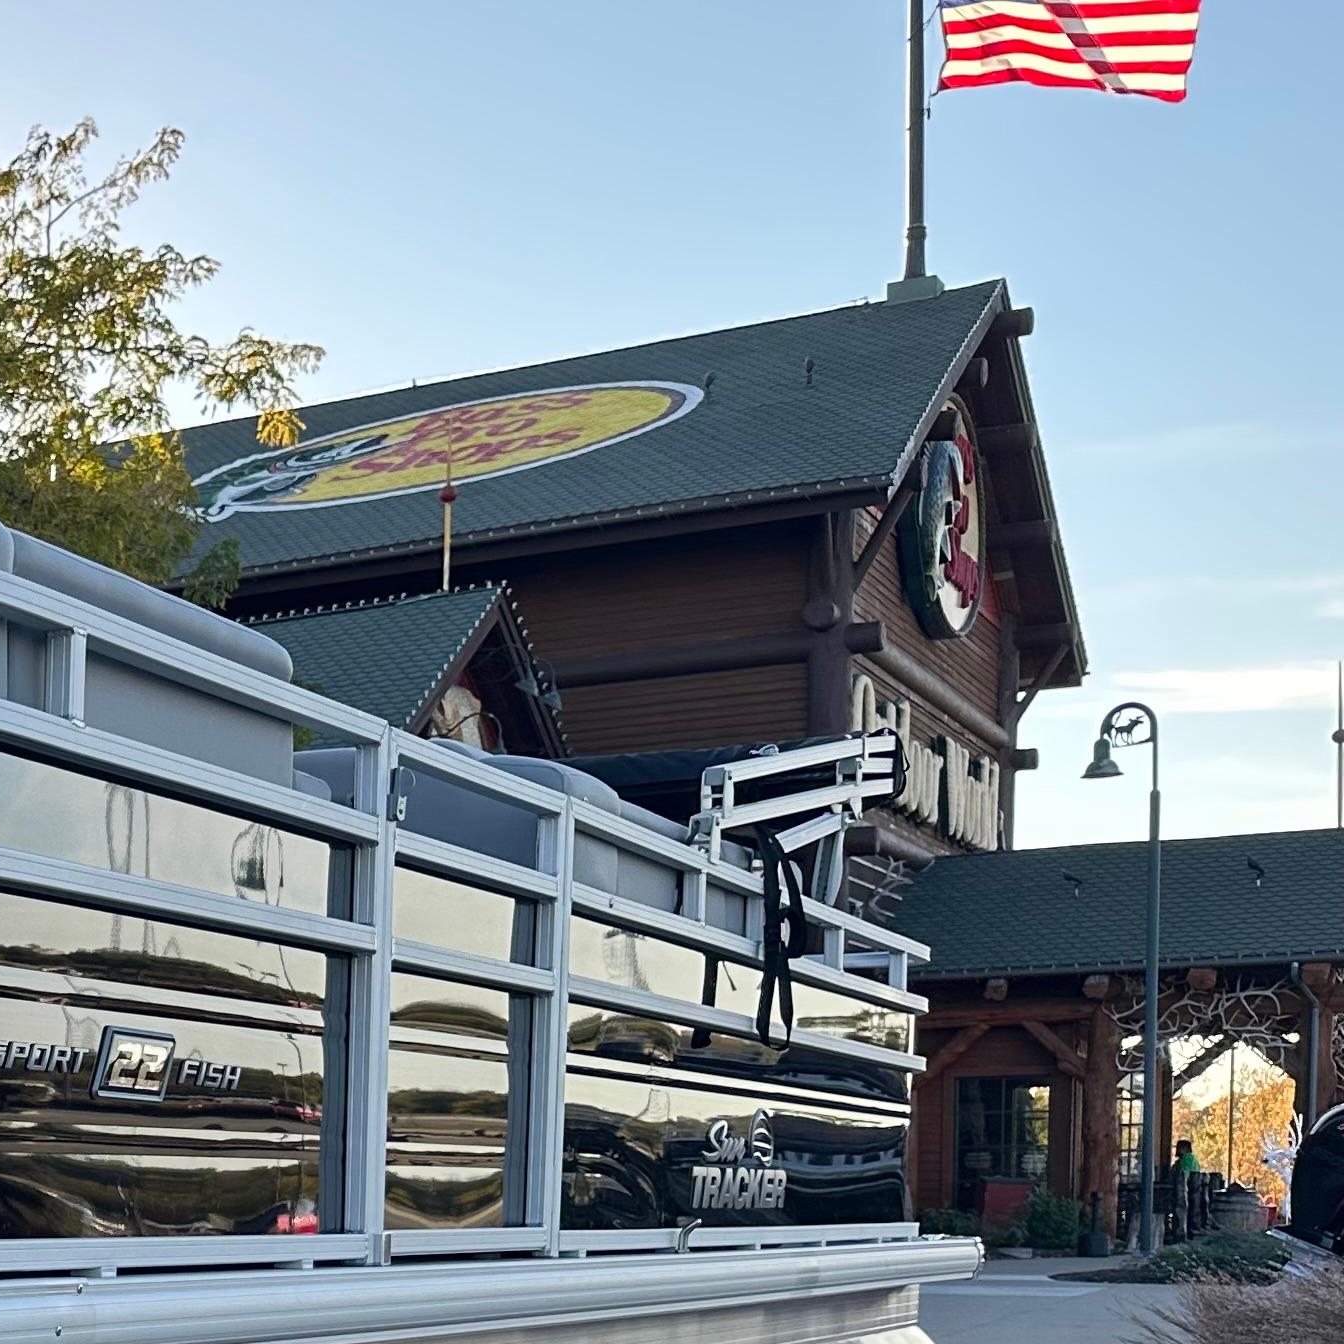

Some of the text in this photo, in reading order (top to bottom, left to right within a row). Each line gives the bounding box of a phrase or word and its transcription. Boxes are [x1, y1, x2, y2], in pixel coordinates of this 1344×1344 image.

[328, 427, 583, 481] Shops
[108, 1042, 168, 1091] 22
[176, 1060, 242, 1091] FISH
[702, 1119, 746, 1164] Sun
[691, 1165, 788, 1210] TRACKER
